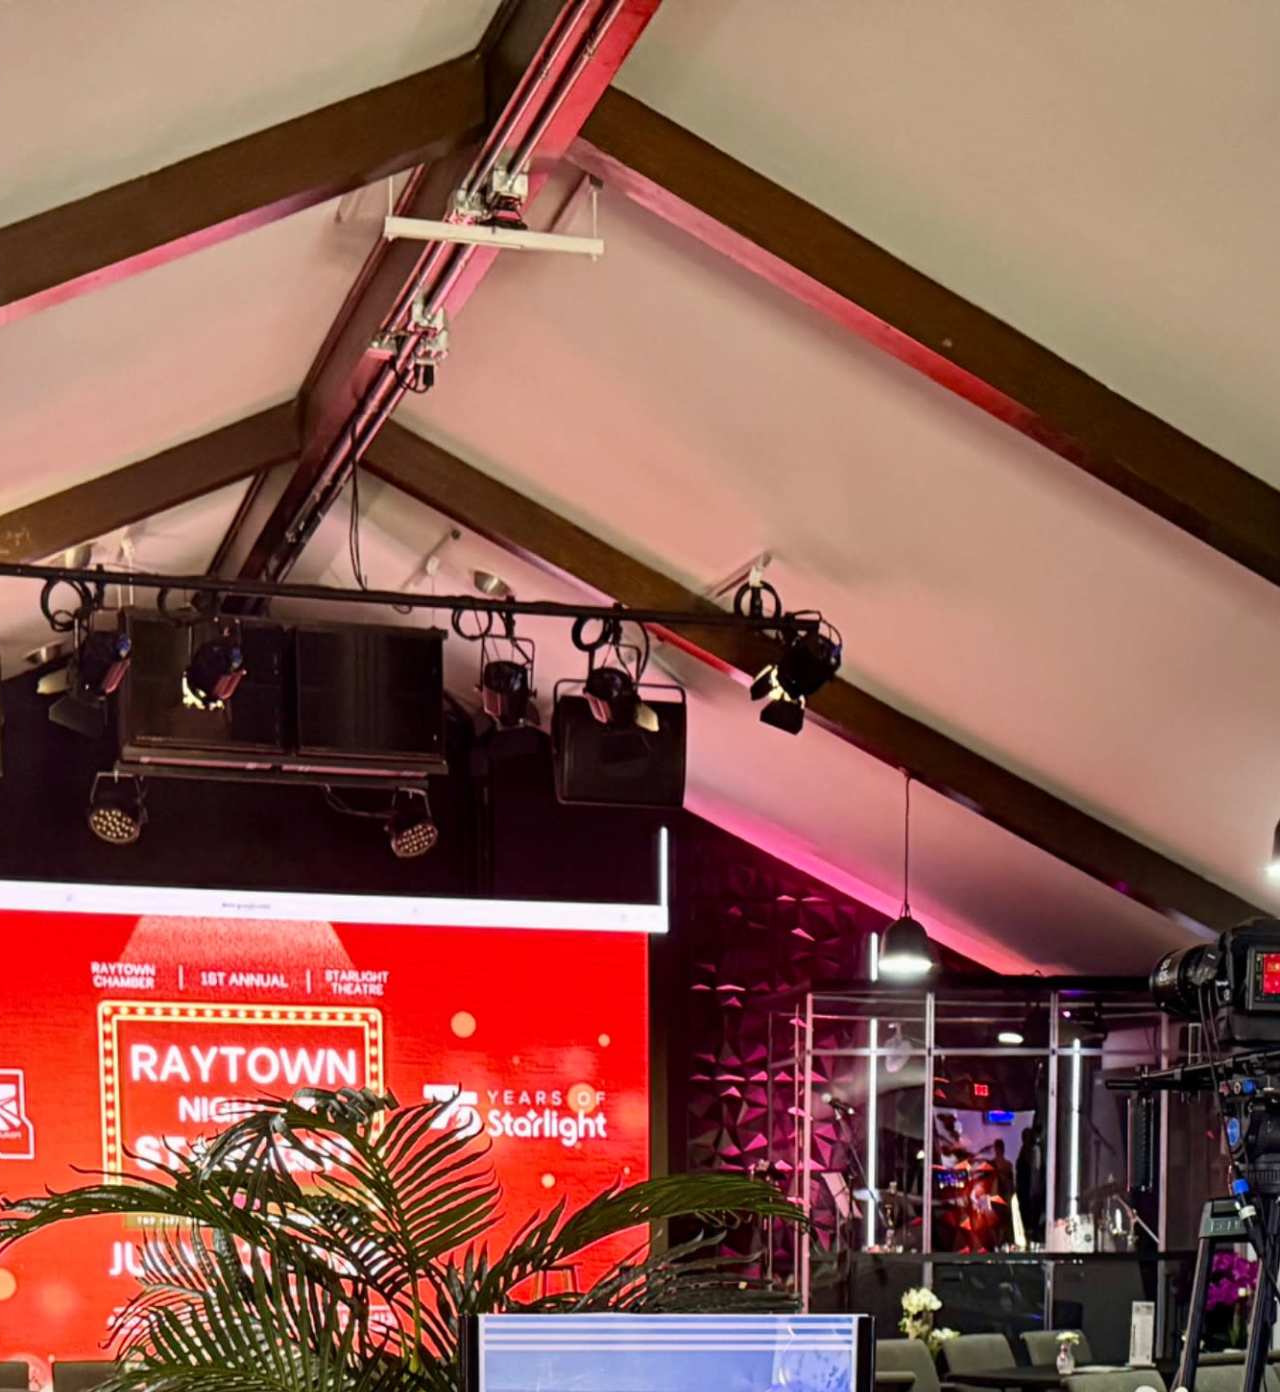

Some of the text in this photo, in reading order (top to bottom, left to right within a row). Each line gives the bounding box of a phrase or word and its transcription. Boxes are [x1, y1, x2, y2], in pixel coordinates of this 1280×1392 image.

[91, 962, 156, 976] RAYTOWN
[324, 969, 389, 984] STARLIGHT
[93, 975, 155, 989] CHAMBER
[229, 971, 288, 988] ANNUAL
[130, 1044, 357, 1085] RAYTOWN
[487, 1091, 606, 1105] YEARS OF
[486, 1108, 607, 1147] Starlight
